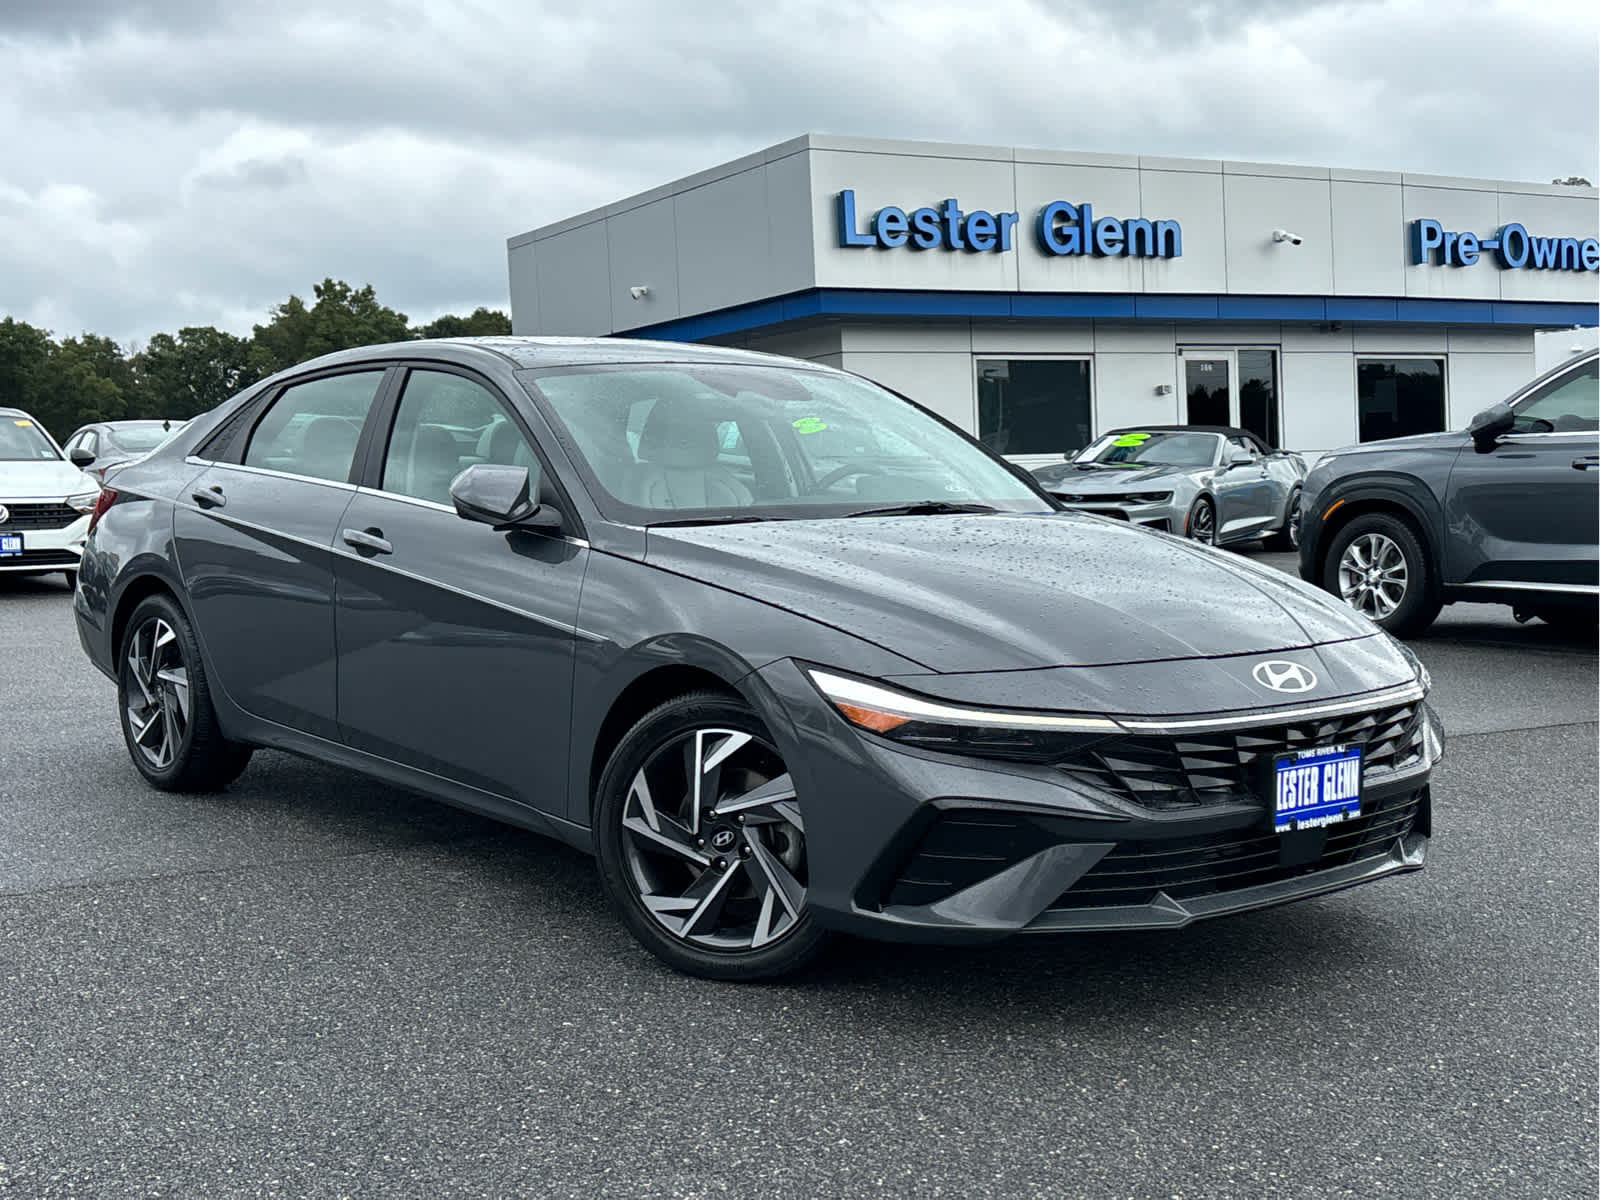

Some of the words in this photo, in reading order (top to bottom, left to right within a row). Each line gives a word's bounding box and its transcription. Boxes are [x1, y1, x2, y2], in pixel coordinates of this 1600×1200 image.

[839, 189, 1019, 252] Lester
[1036, 200, 1182, 257] Glenn
[1298, 749, 1316, 759] TOMS
[1276, 766, 1319, 811] LESTER
[1323, 759, 1359, 802] GLENN
[1297, 813, 1343, 830] lesterglenn
